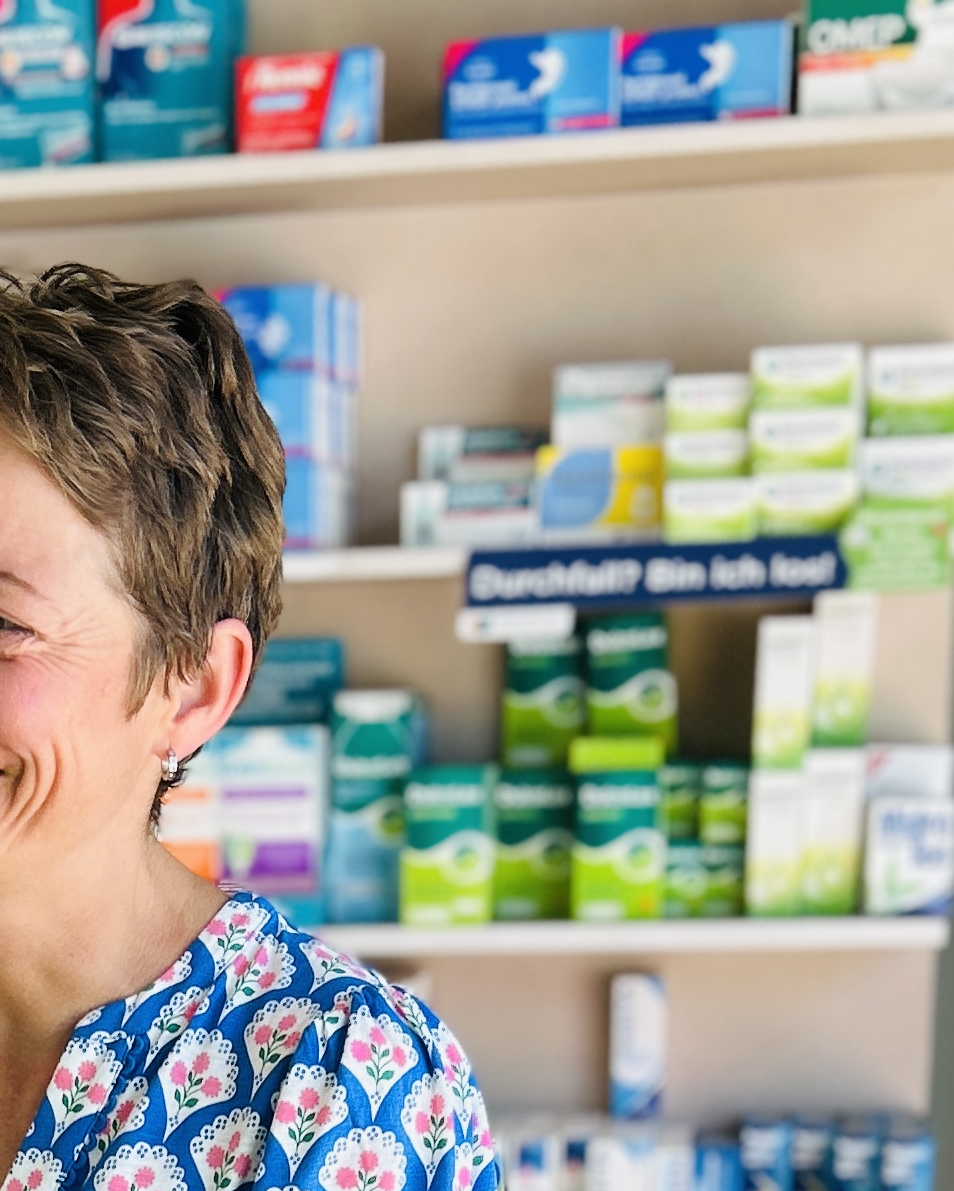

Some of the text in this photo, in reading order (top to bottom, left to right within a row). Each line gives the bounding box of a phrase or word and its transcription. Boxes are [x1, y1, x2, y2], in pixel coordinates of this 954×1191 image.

[807, 15, 908, 53] OMEP
[470, 558, 643, 600] Durchfall?
[645, 556, 705, 593] Bin
[770, 550, 837, 586] los!
